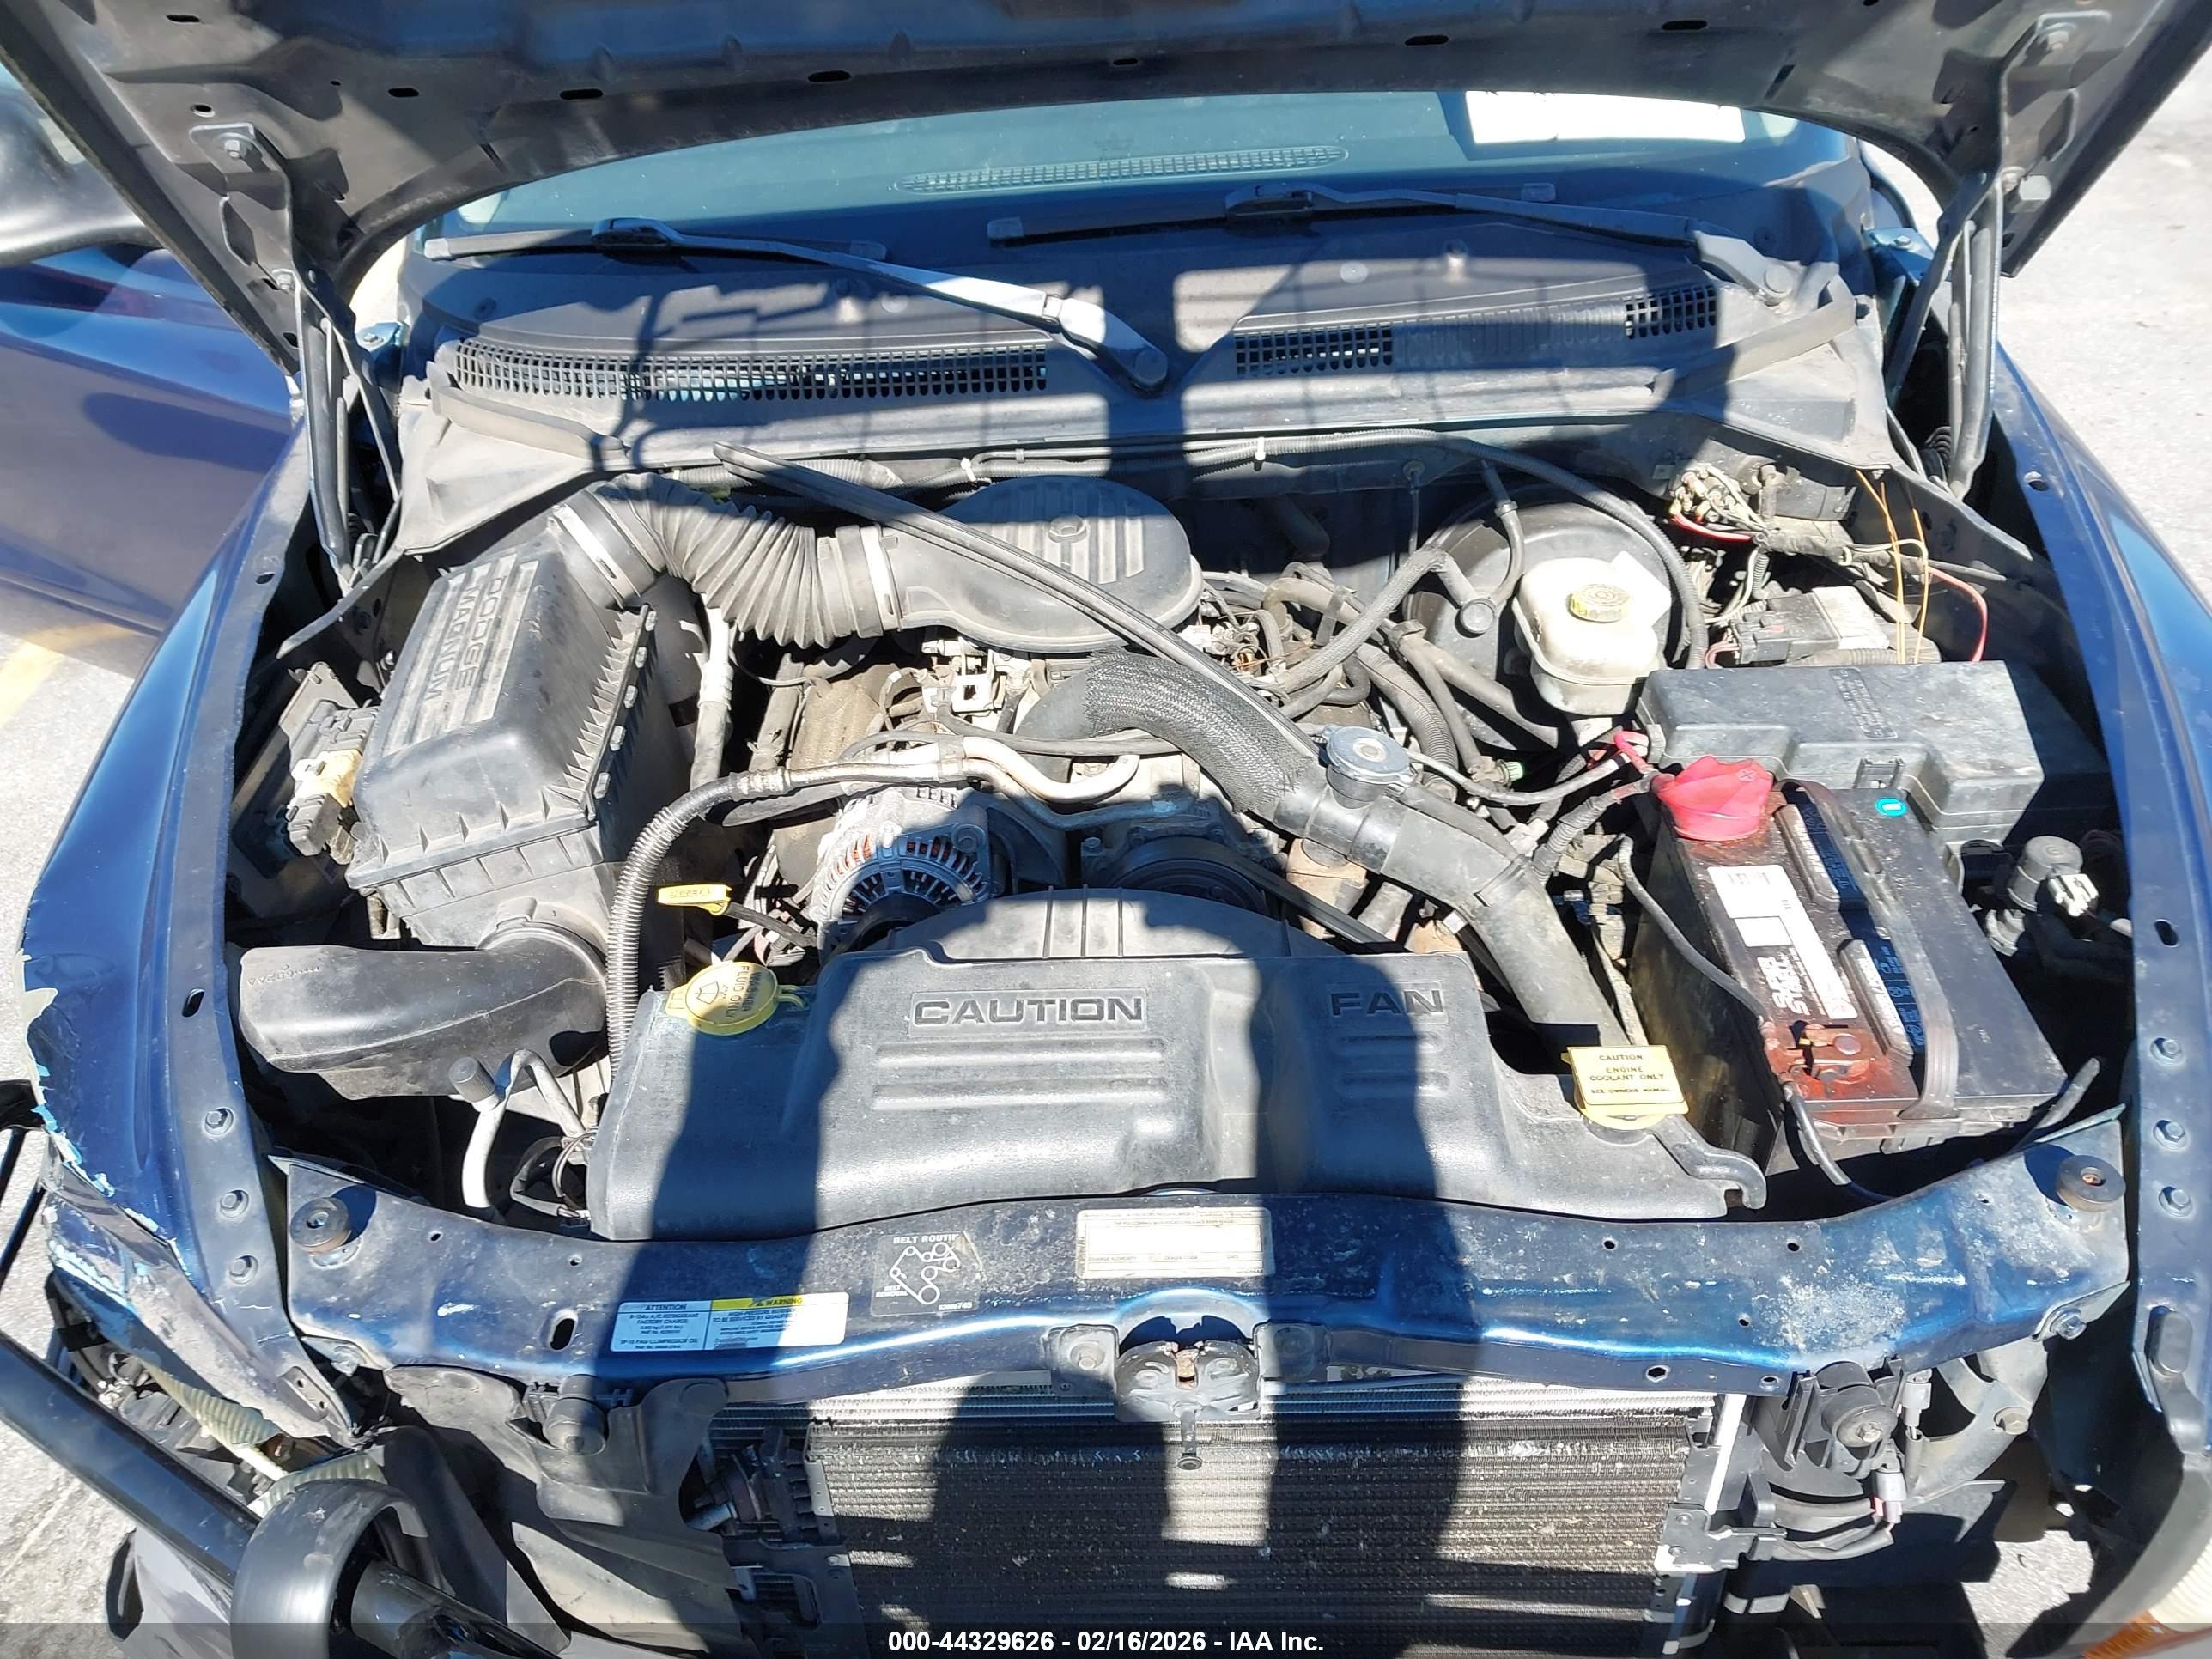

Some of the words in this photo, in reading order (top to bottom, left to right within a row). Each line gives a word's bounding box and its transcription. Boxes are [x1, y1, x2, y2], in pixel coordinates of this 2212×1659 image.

[424, 585, 481, 701] MAGNUM
[455, 575, 507, 690] DODGE
[733, 966, 750, 994] FLUID
[1757, 957, 1788, 1009] SUPER
[1774, 957, 1811, 1016] START
[726, 994, 742, 1019] ONLY
[913, 997, 1143, 1025] CAUTION
[1330, 988, 1444, 1016] FAN
[893, 1236, 919, 1244] BELT
[921, 1234, 959, 1243] ROUTIN
[765, 1297, 803, 1306] WARNING
